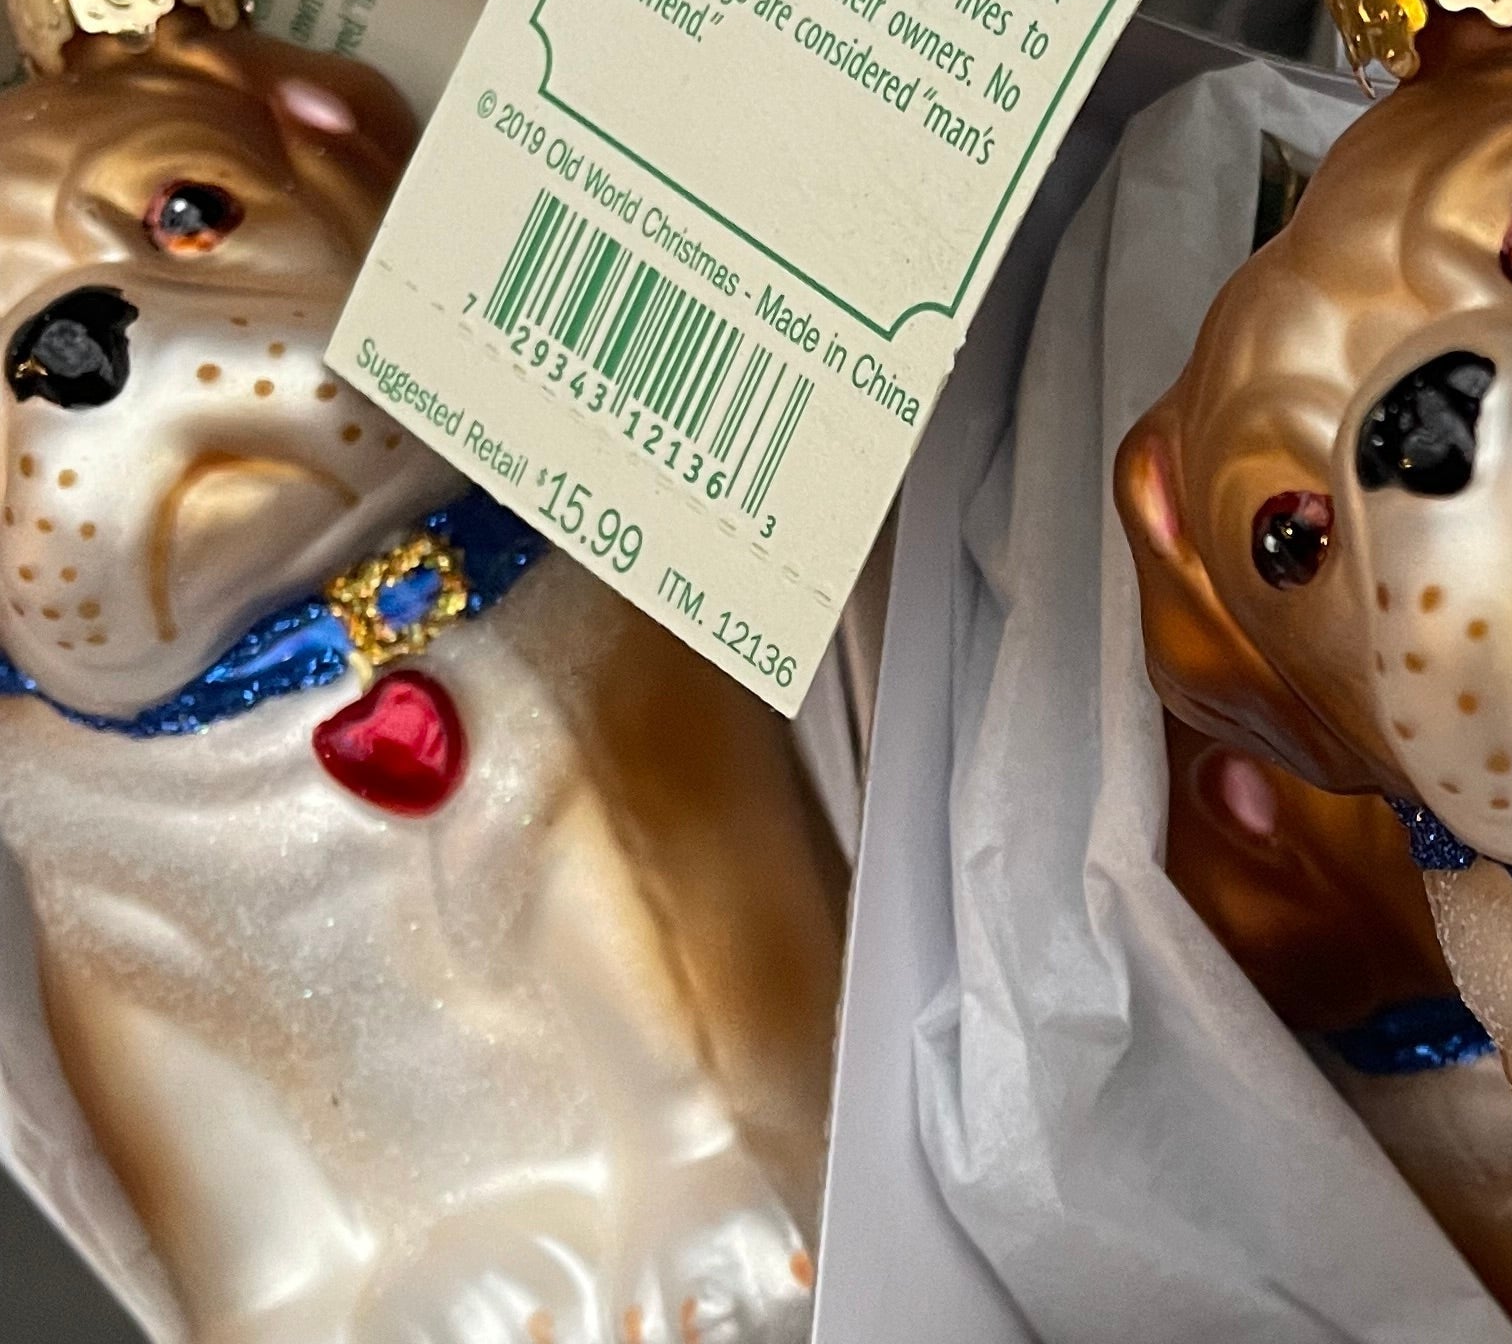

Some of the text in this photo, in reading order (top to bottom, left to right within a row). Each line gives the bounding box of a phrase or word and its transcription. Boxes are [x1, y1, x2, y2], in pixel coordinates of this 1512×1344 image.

[794, 16, 921, 113] considered
[887, 10, 975, 87] owners.
[983, 62, 1021, 113] No
[1020, 20, 1050, 60] to
[494, 103, 546, 155] 2019
[545, 138, 585, 182] Old
[583, 162, 643, 225] World
[641, 206, 741, 297] Christmas
[754, 283, 821, 353] Made
[822, 332, 848, 374] in
[851, 353, 920, 427] China
[356, 337, 465, 437] Suggested
[463, 419, 529, 487] Retail
[462, 292, 777, 539] 7 29343 12136 3
[657, 566, 797, 688] ITM. 12136
